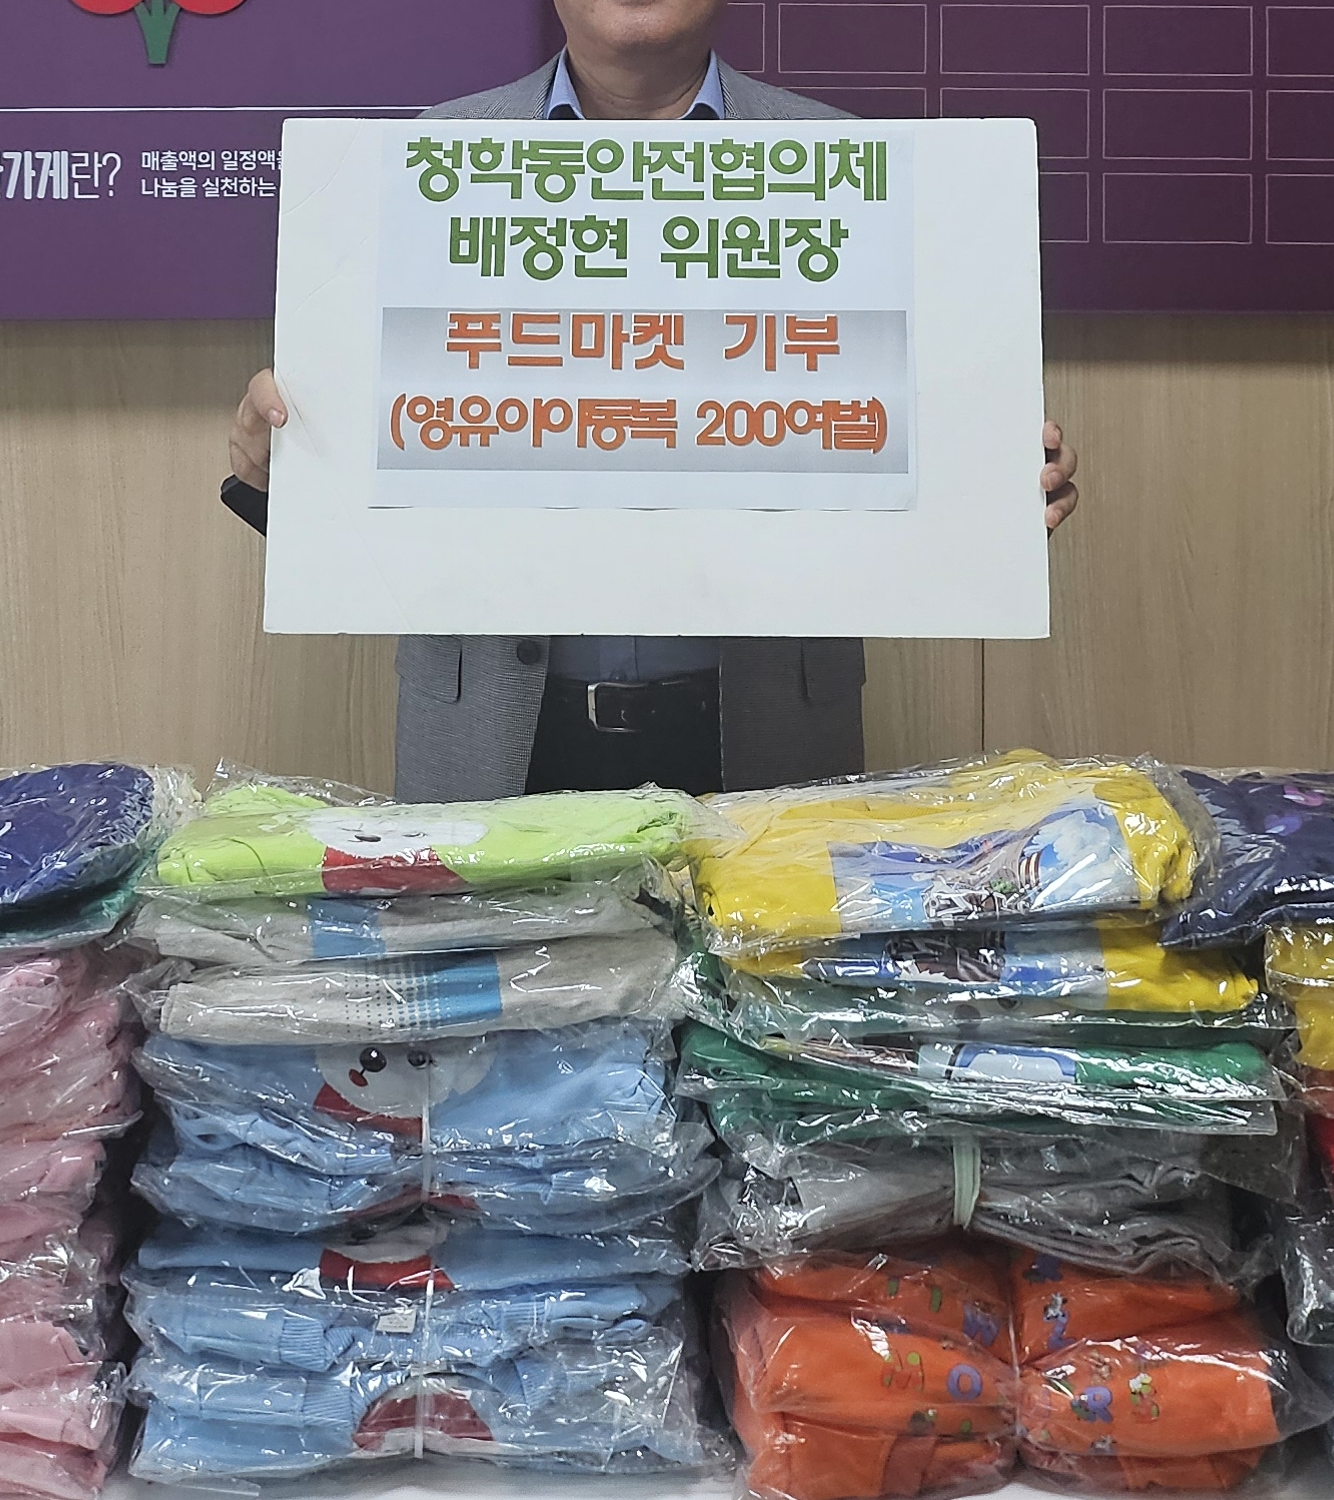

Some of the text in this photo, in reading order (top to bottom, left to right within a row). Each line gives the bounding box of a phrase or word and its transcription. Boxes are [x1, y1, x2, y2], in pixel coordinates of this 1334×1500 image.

[140, 150, 216, 172] 매출액의
[140, 176, 278, 199] 나눔을 실천하는
[404, 136, 888, 203] 청학동안전협의체
[448, 215, 849, 282] 배정현 위원장
[445, 311, 841, 373] 푸드마켓 기부
[695, 395, 888, 456] 200여벌)
